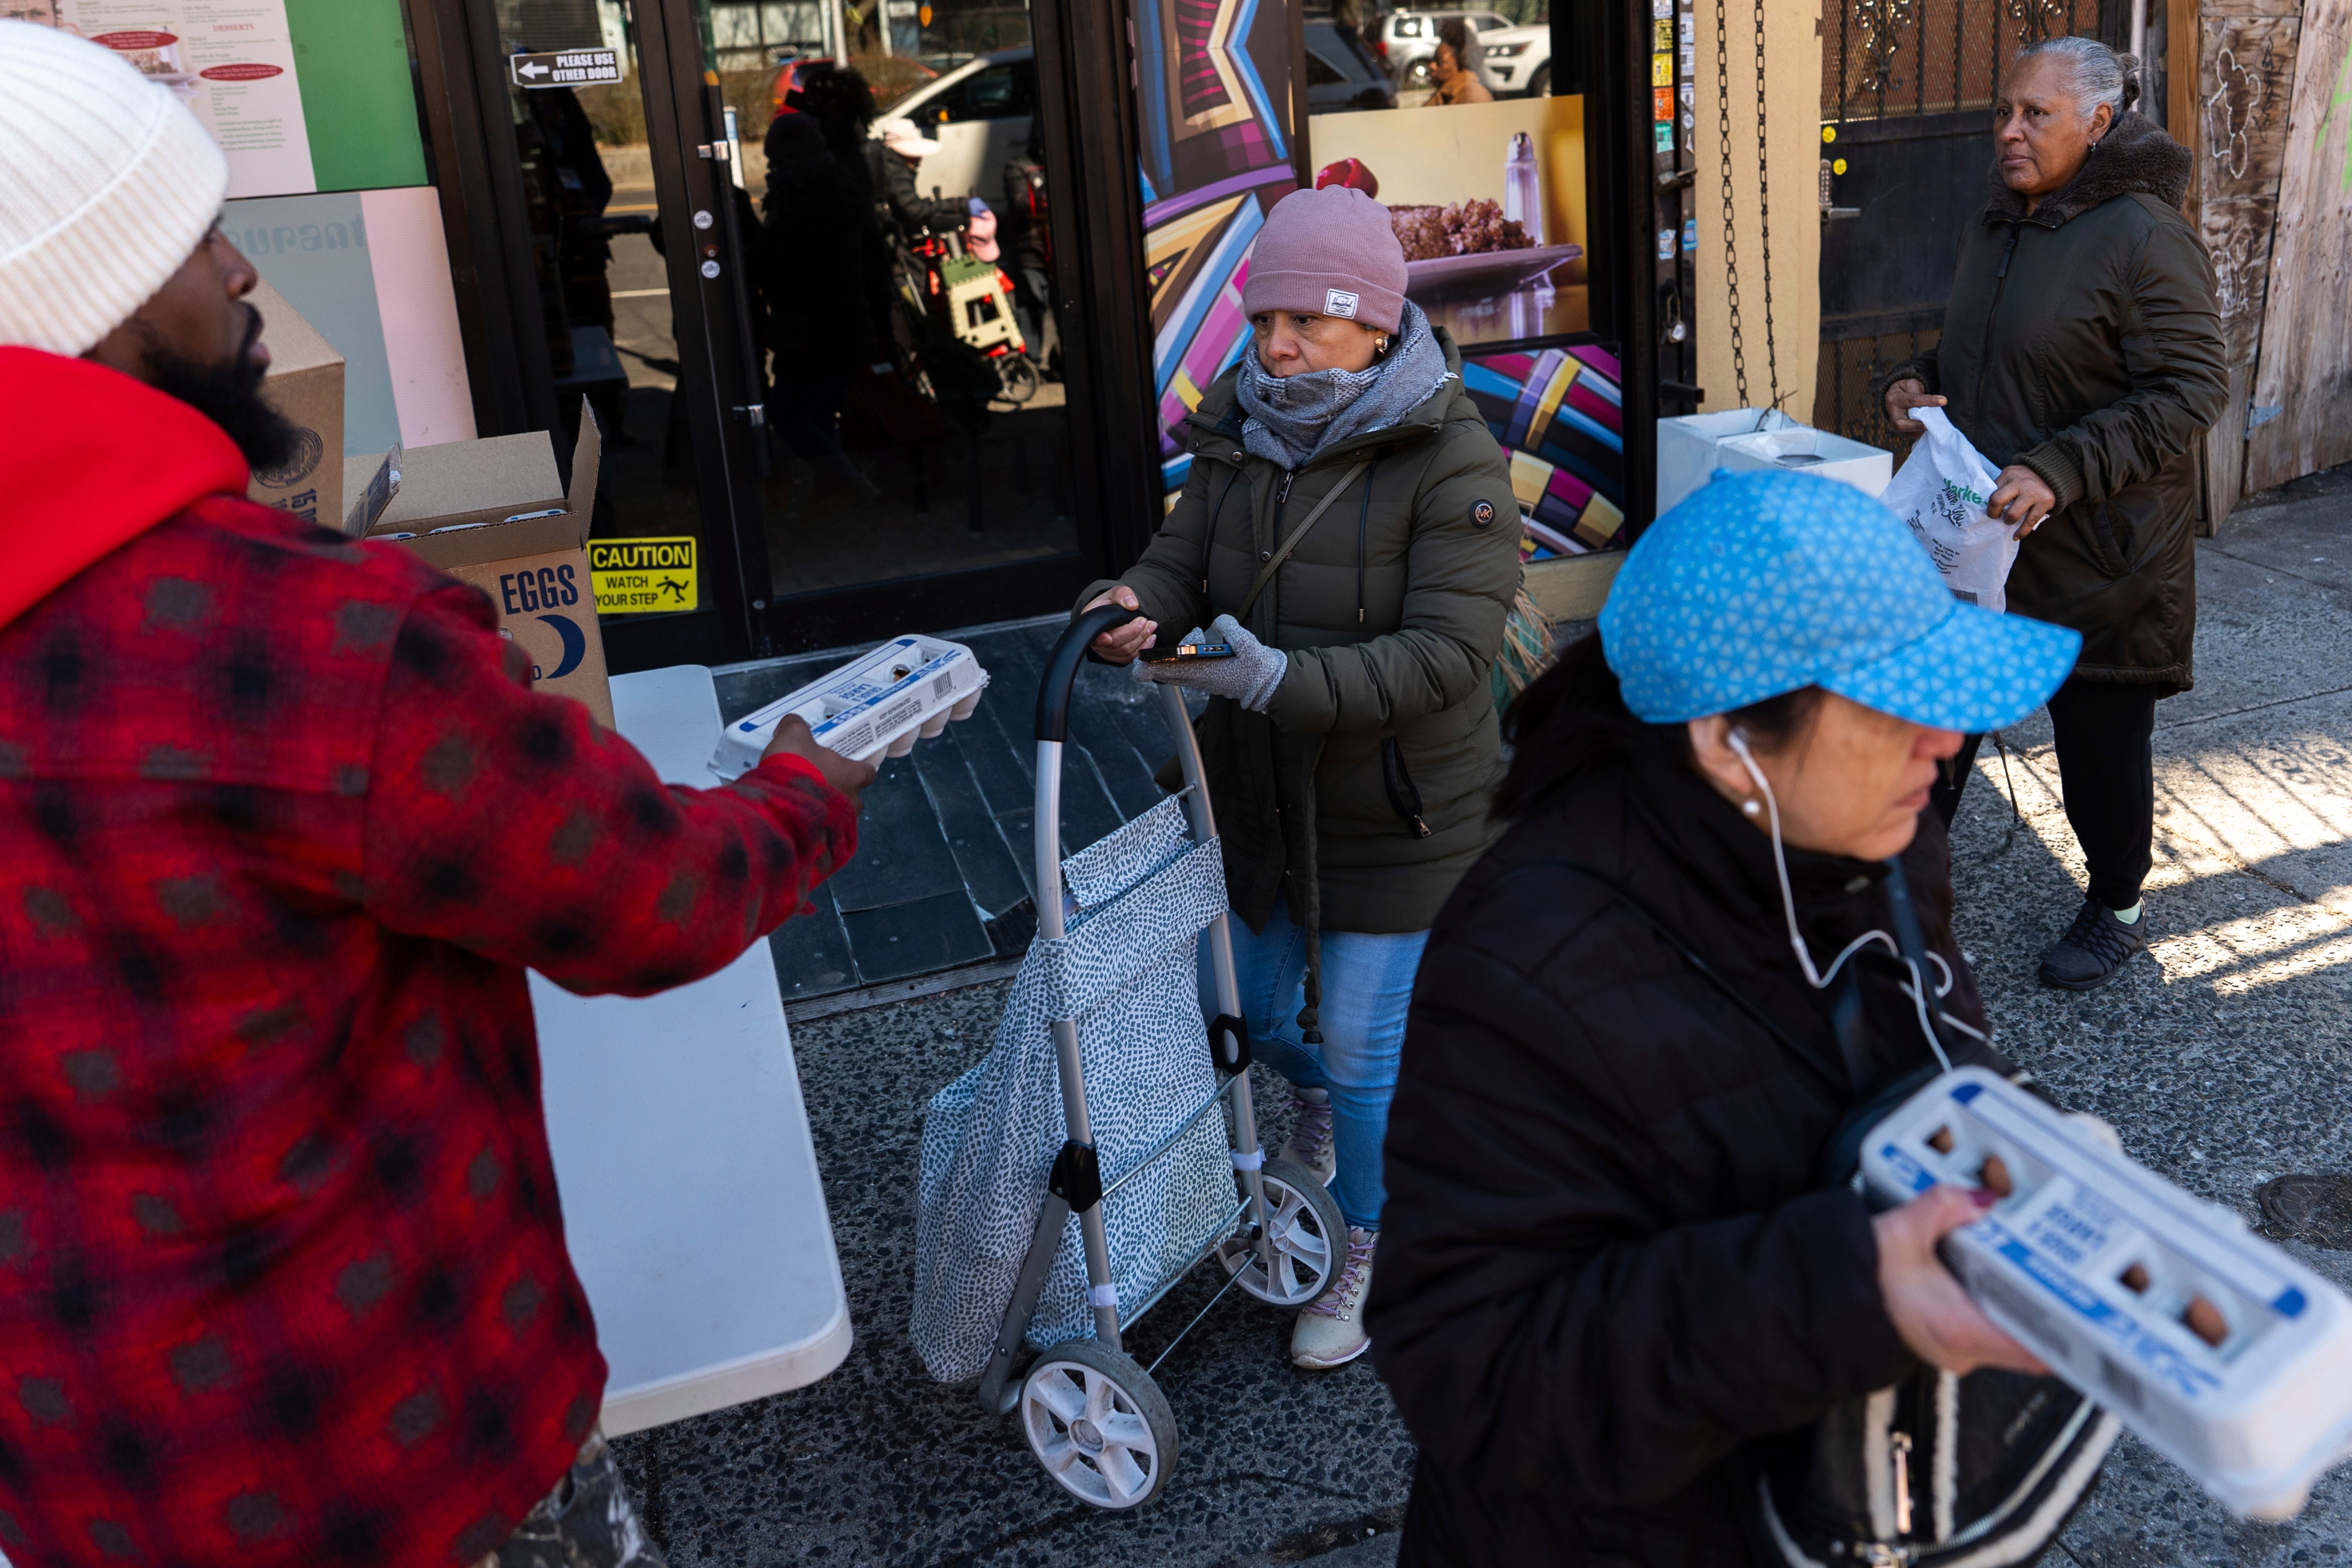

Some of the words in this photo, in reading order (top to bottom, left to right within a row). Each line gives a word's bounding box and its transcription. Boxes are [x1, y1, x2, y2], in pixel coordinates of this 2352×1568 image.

[556, 54, 594, 67] PLEASE
[594, 53, 615, 65] USE
[552, 68, 587, 82] OTHER
[587, 66, 617, 80] DOOR
[225, 215, 365, 256] aurant
[1944, 478, 1988, 506] Marke
[1477, 508, 1491, 519] MK
[593, 545, 690, 568] CAUTION
[499, 564, 579, 615] EGGS
[606, 576, 648, 589] WATCH
[594, 594, 628, 606] YOUR
[630, 592, 658, 605] STEP
[839, 683, 873, 699] LARGE
[832, 703, 872, 726] EGGS
